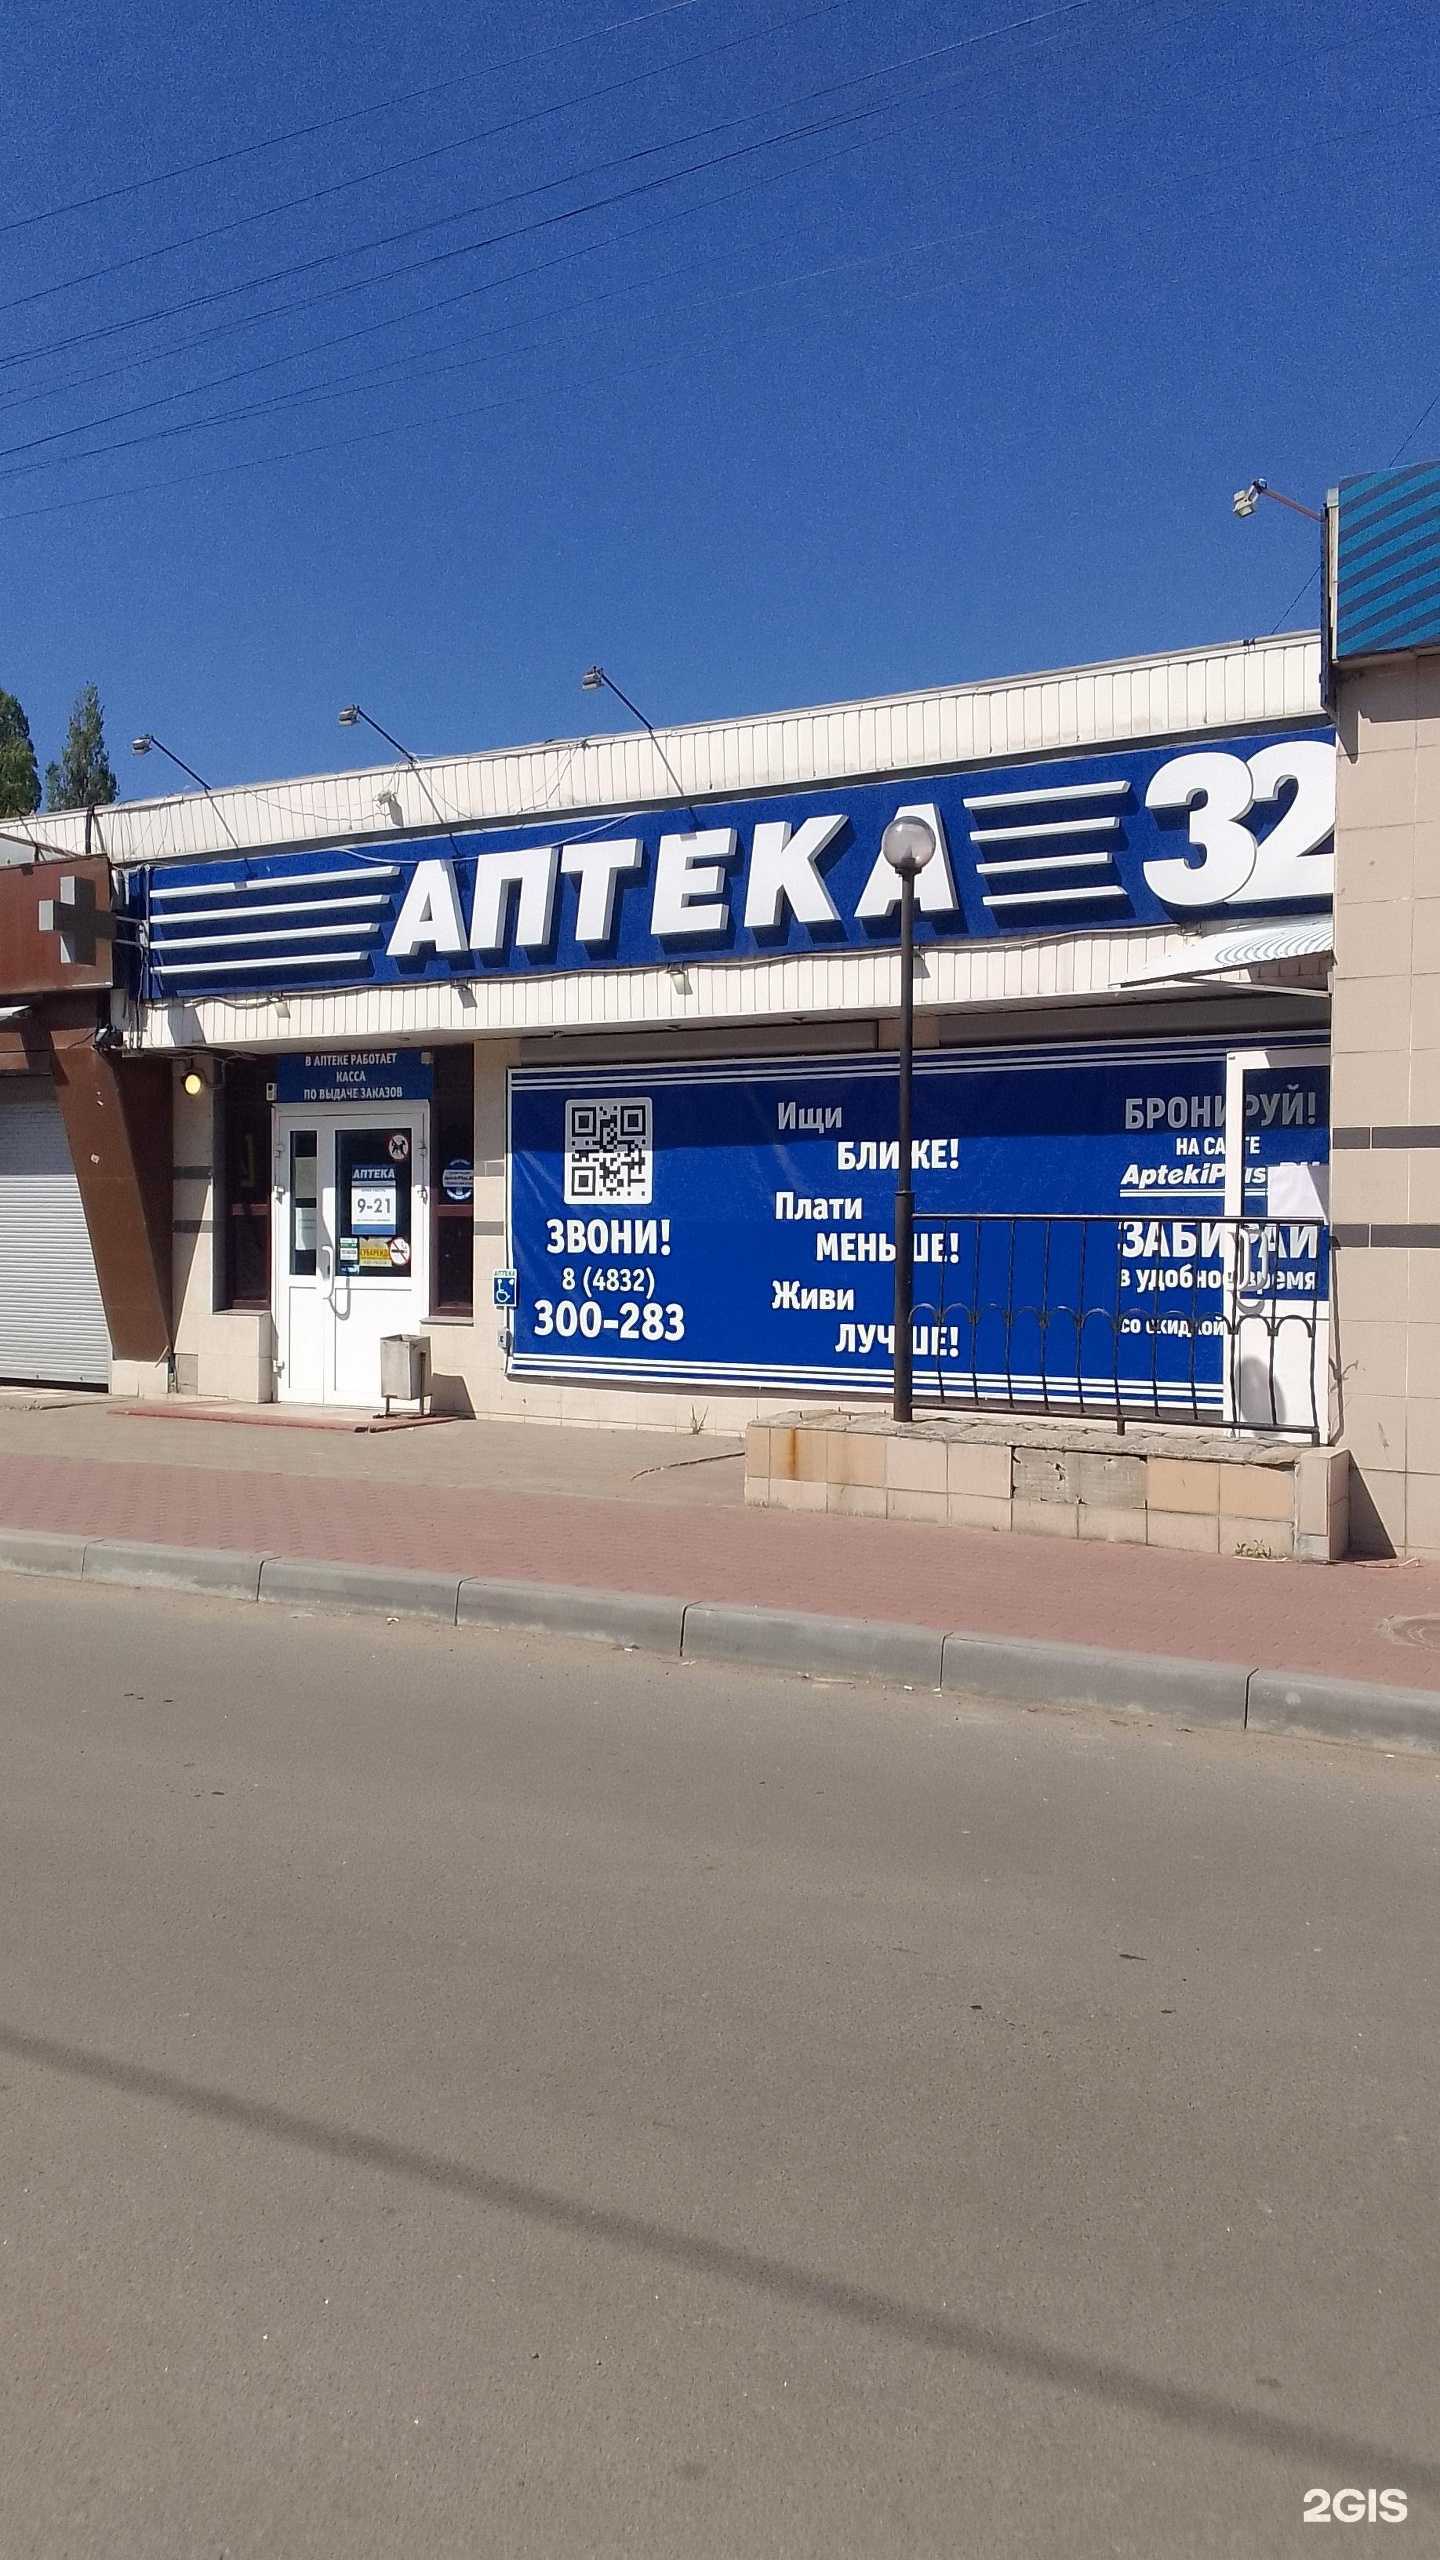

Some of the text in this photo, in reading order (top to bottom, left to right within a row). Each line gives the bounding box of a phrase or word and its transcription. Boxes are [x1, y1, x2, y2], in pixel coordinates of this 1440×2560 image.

[386, 740, 1336, 957] АПТЕКА 32
[305, 1052, 398, 1067] В АПТЕКЕ РАБОТАЕТ
[336, 1071, 366, 1083] КАССА
[304, 1086, 403, 1101] ПО ВЫДАЧЕ ЗАКАЗОВ
[777, 1101, 842, 1134] Ищи
[1176, 1136, 1260, 1155] НА САЕ
[352, 1168, 395, 1179] АПТЕКА
[357, 1197, 391, 1213] 9-21
[775, 1191, 863, 1220] Плати
[546, 1218, 671, 1256] ЗВОНИ!
[562, 1265, 655, 1299] 8 (4832)
[1120, 1269, 1131, 1287] в
[772, 1280, 854, 1311] Живи
[534, 1300, 685, 1341] 300-283
[1120, 1318, 1141, 1334] со
